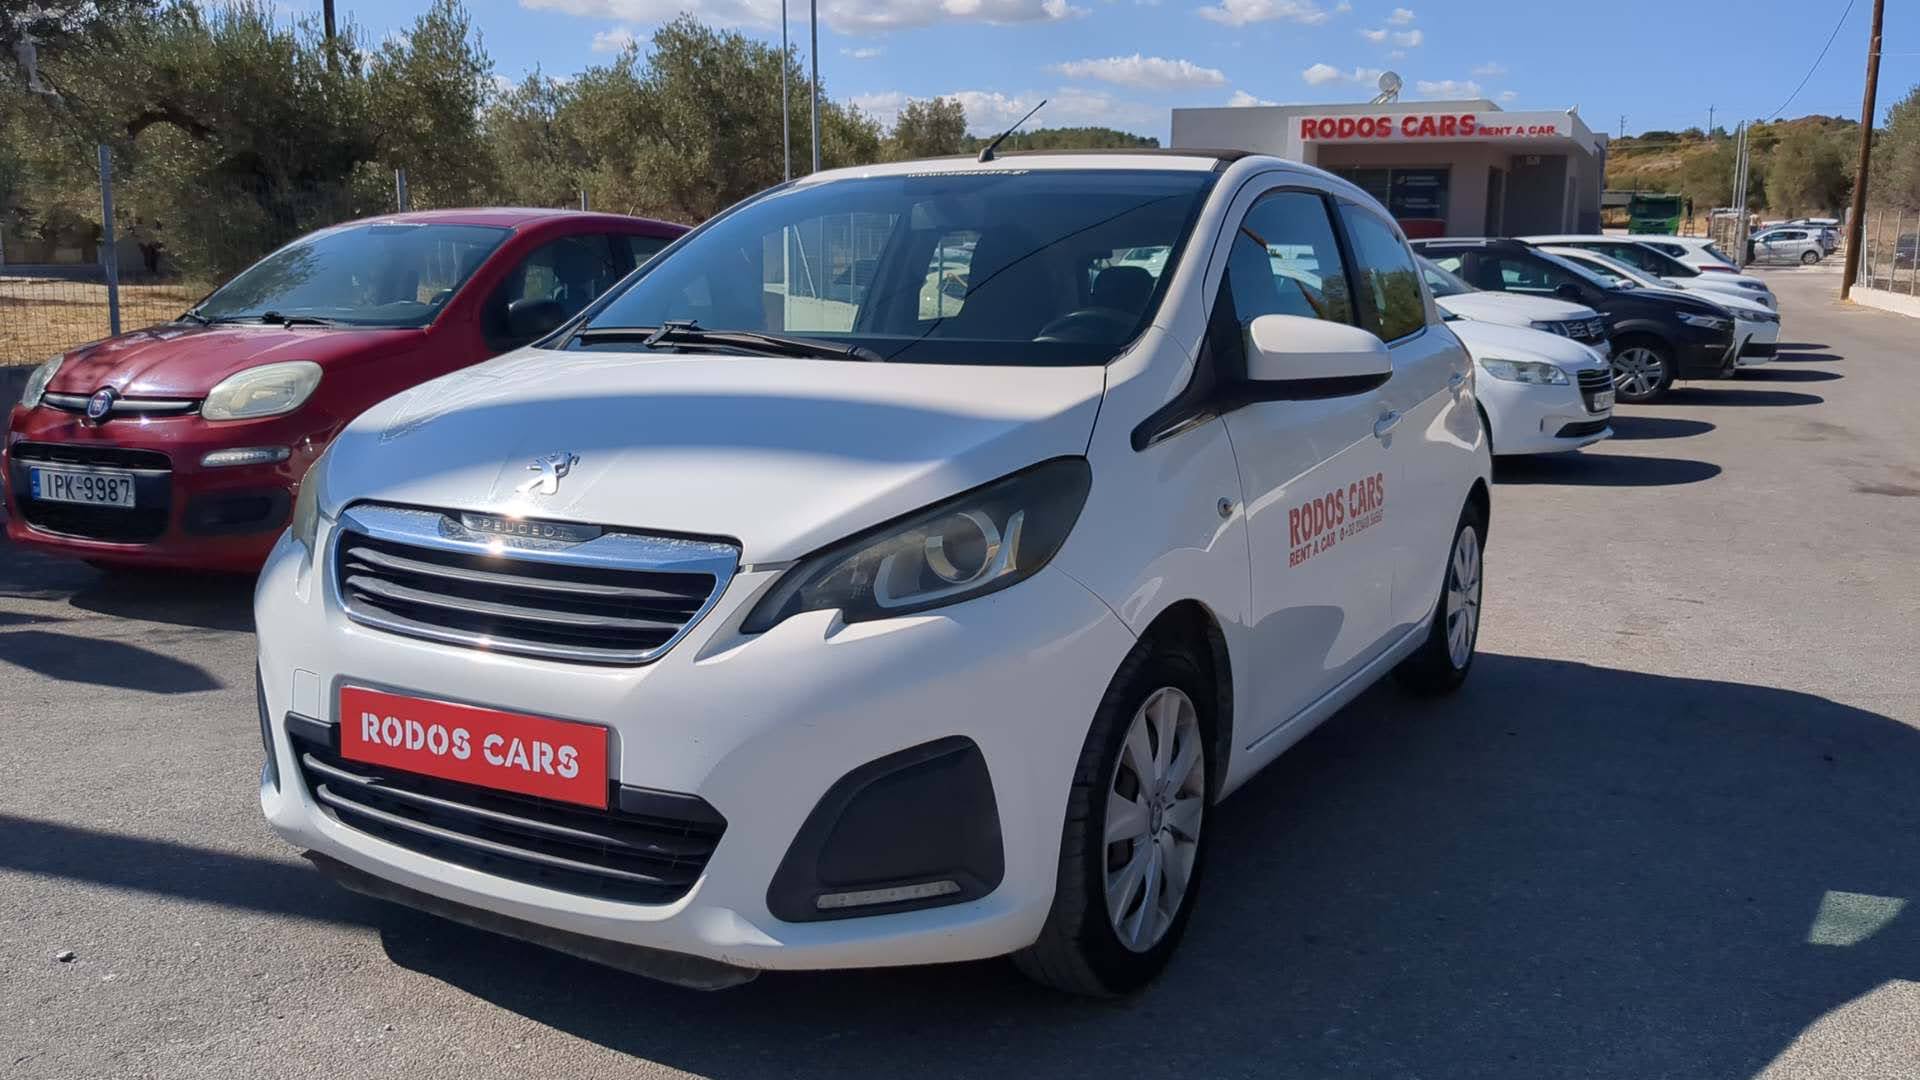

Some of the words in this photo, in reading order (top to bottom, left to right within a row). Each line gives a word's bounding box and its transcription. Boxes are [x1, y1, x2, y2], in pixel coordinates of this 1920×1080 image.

[1301, 118, 1392, 140] RODOS
[1401, 115, 1476, 137] CARS
[1479, 126, 1512, 136] RENT
[1515, 126, 1525, 135] A
[1528, 125, 1555, 135] CAR
[480, 517, 566, 539] PEUGEOT
[1289, 488, 1345, 548] RODOS
[1349, 472, 1383, 518] CARS
[1289, 543, 1312, 568] RENT
[1313, 540, 1319, 556] A
[1320, 532, 1336, 552] CAR
[361, 712, 472, 760] RODOS
[483, 733, 579, 779] CARS
